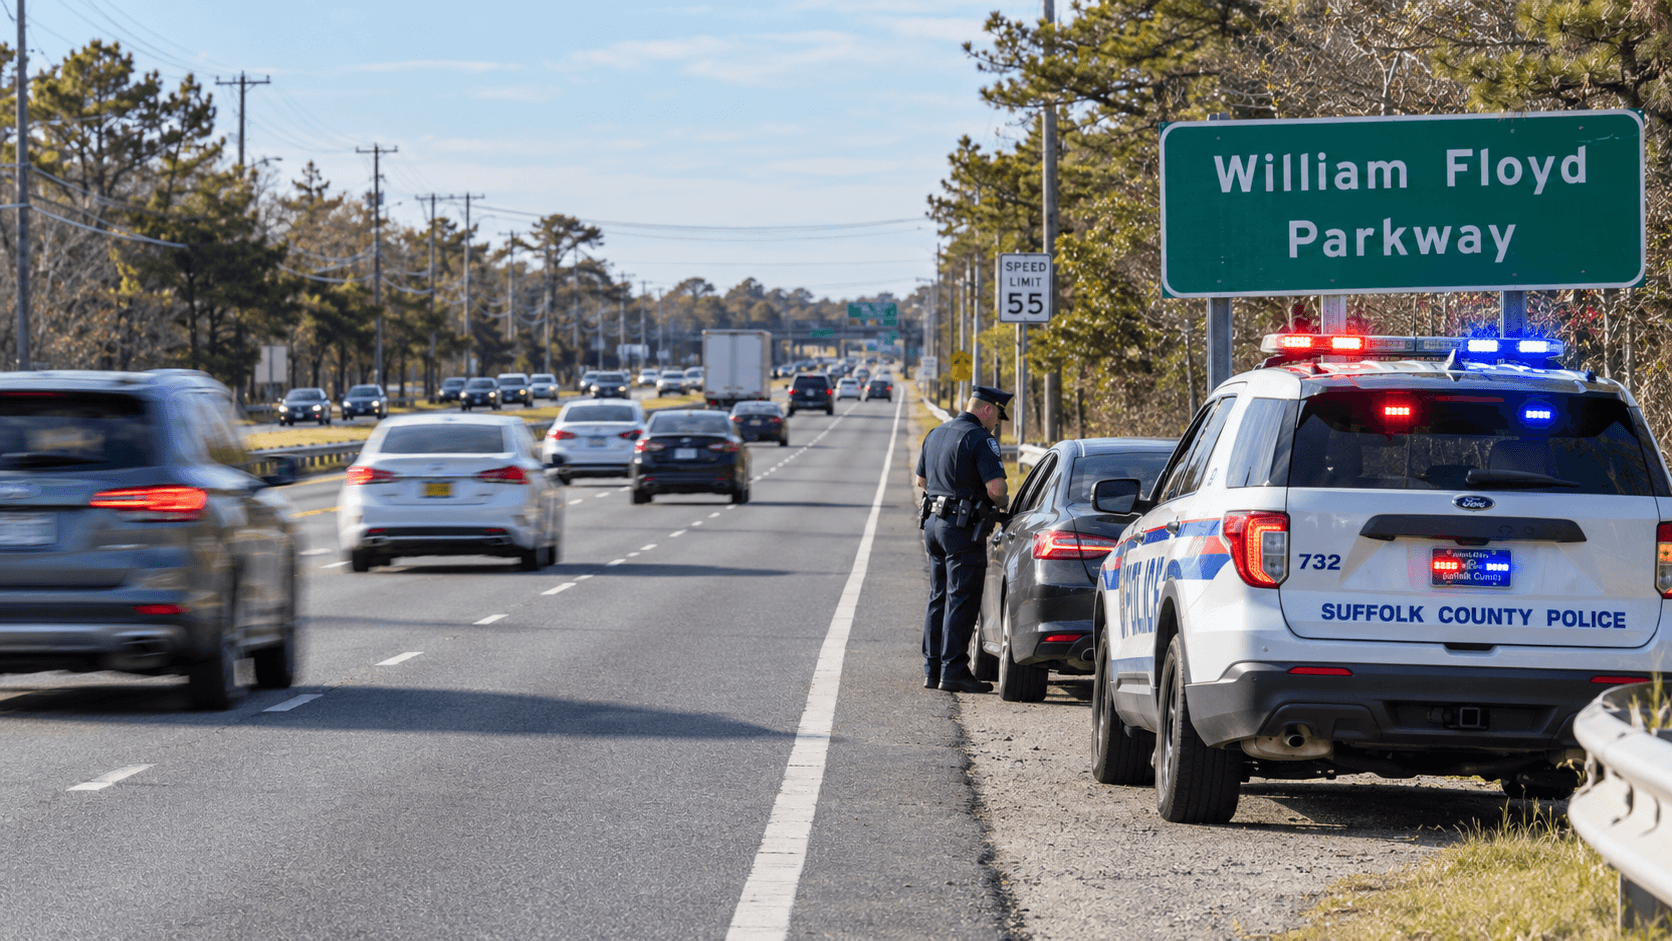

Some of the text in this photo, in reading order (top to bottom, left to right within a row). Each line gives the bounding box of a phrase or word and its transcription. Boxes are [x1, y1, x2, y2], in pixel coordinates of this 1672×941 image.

[1213, 145, 1587, 195] William Floyd
[1288, 217, 1516, 263] Parkway
[1005, 261, 1047, 273] SPEED
[1009, 277, 1042, 287] LIMIT
[1007, 292, 1044, 315] 55
[1298, 553, 1341, 571] 732
[1321, 602, 1627, 629] SUFFOLK COUNTY POLICE
